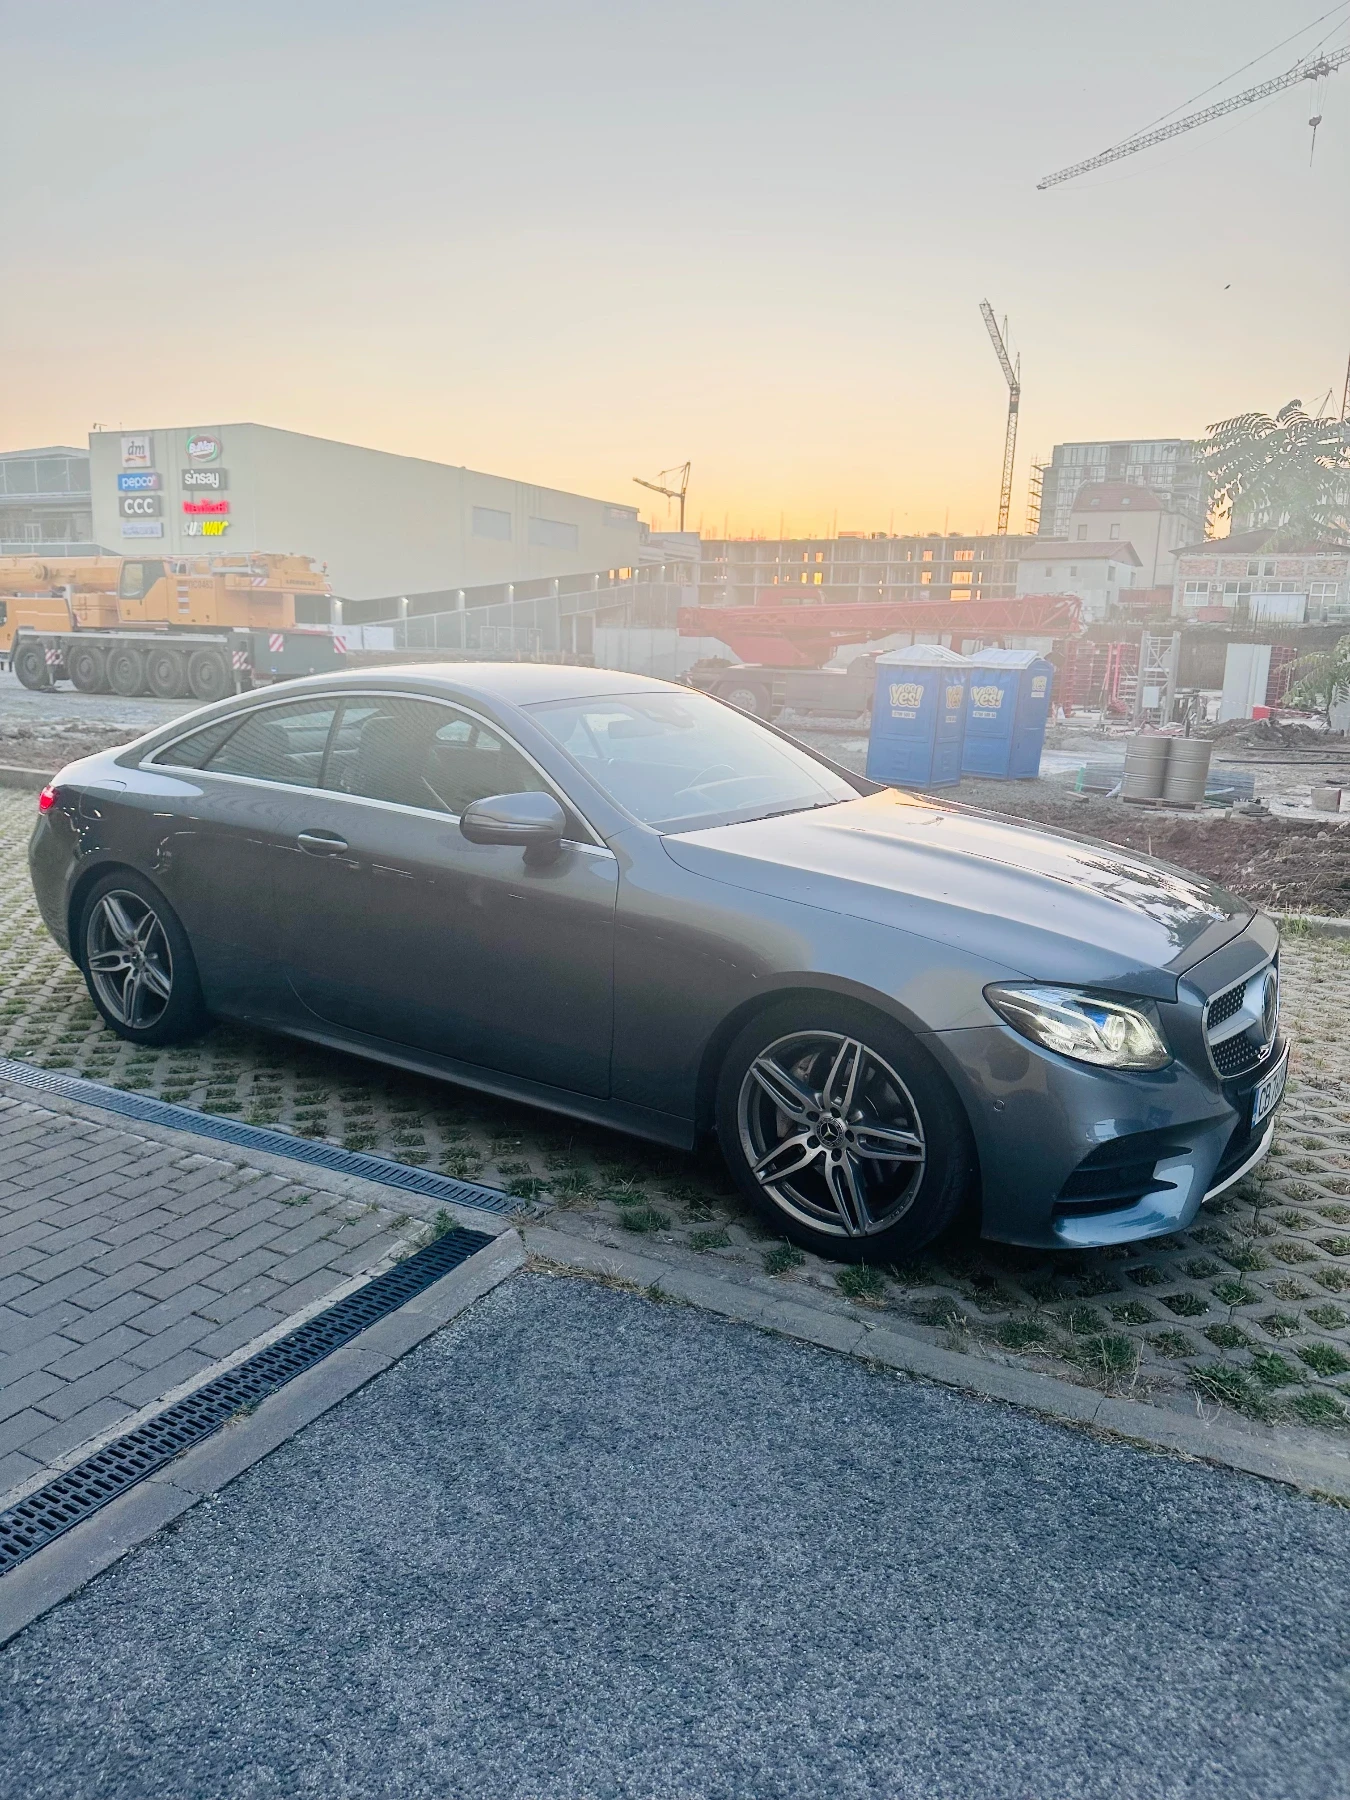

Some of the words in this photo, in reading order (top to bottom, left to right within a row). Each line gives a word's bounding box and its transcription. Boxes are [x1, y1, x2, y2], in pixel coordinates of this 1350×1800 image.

[128, 441, 145, 456] dm
[122, 476, 154, 489] pepco
[184, 470, 220, 488] sinsay
[182, 521, 229, 536] SUBWAY
